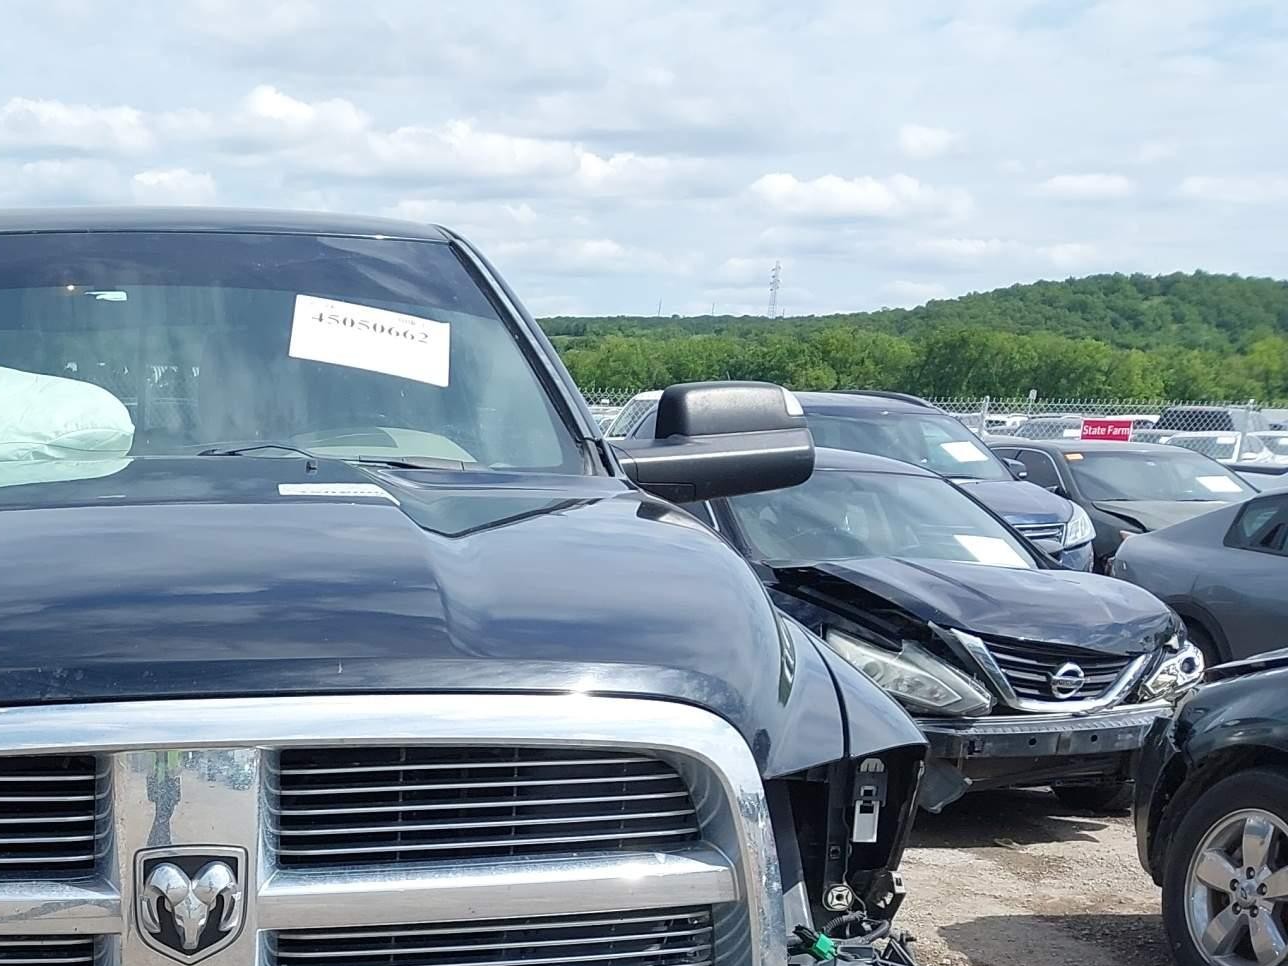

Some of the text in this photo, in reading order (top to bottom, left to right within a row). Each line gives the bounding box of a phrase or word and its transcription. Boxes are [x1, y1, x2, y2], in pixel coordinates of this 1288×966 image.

[311, 312, 430, 345] 45050662
[1082, 424, 1130, 436] State Farm
